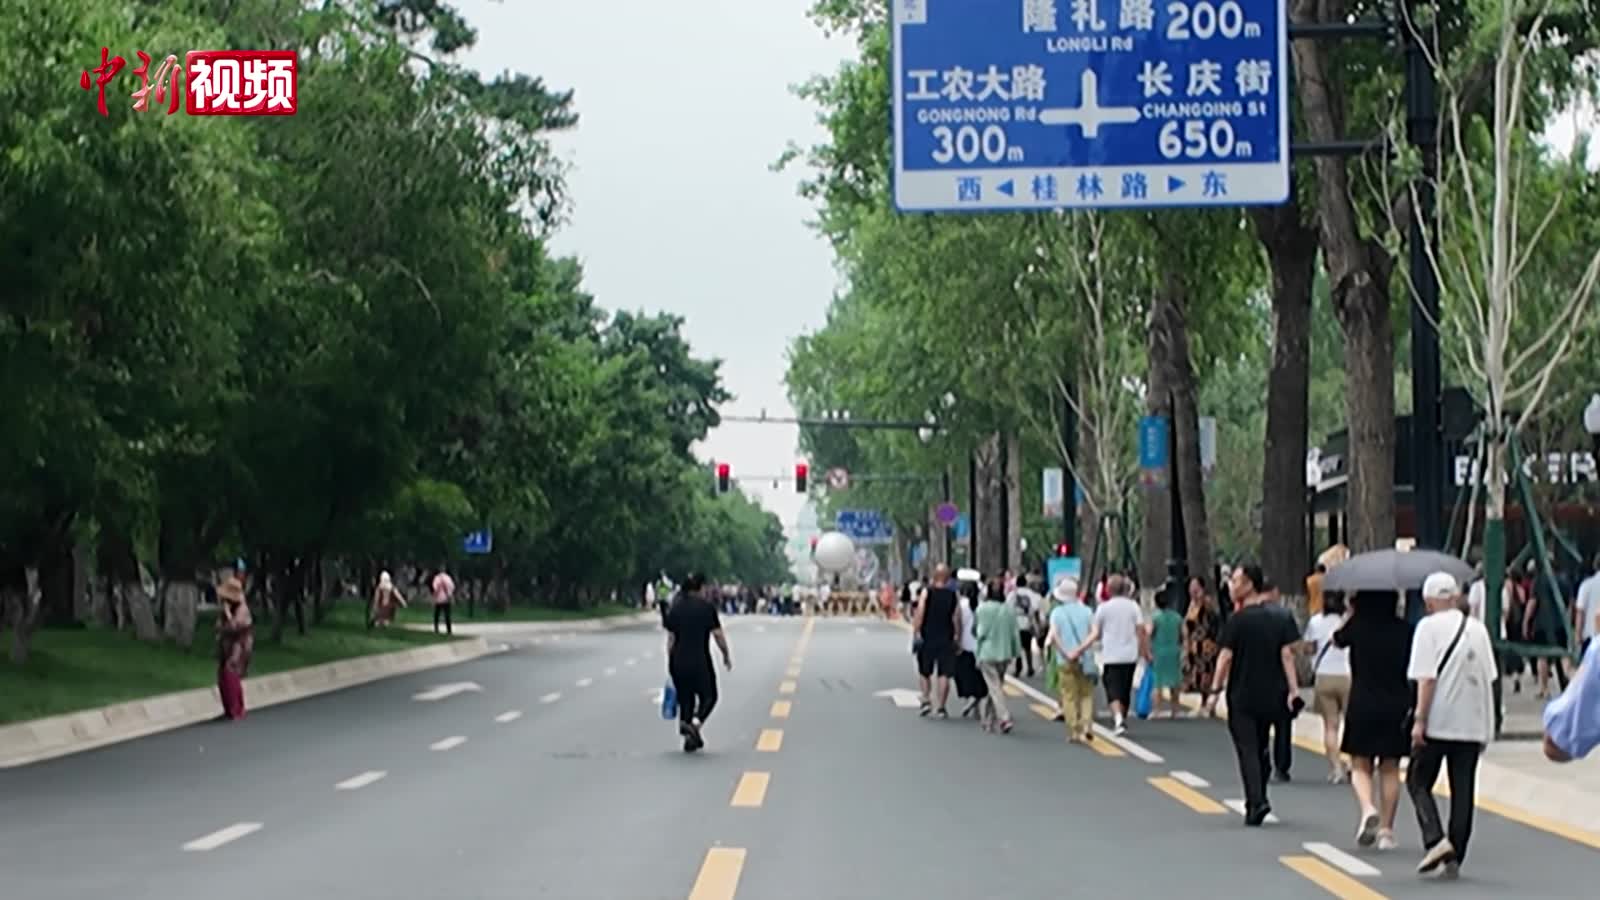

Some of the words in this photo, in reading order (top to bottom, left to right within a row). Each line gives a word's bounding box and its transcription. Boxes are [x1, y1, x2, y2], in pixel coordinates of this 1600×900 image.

[1022, 0, 1155, 33] 隆礼路
[1166, 1, 1261, 39] 200m
[1046, 37, 1107, 52] LONGLI
[1111, 36, 1133, 52] Rd
[906, 64, 1047, 102] 工农大路
[1137, 59, 1272, 97] 长庆街
[917, 107, 1011, 123] GONGNONG
[1015, 107, 1036, 122] Rd
[1247, 102, 1267, 117] St
[931, 125, 1024, 163] 300m
[1158, 120, 1252, 158] 650m
[957, 175, 982, 201] 西
[1031, 172, 1149, 200] 桂林路
[1201, 170, 1228, 198] 东
